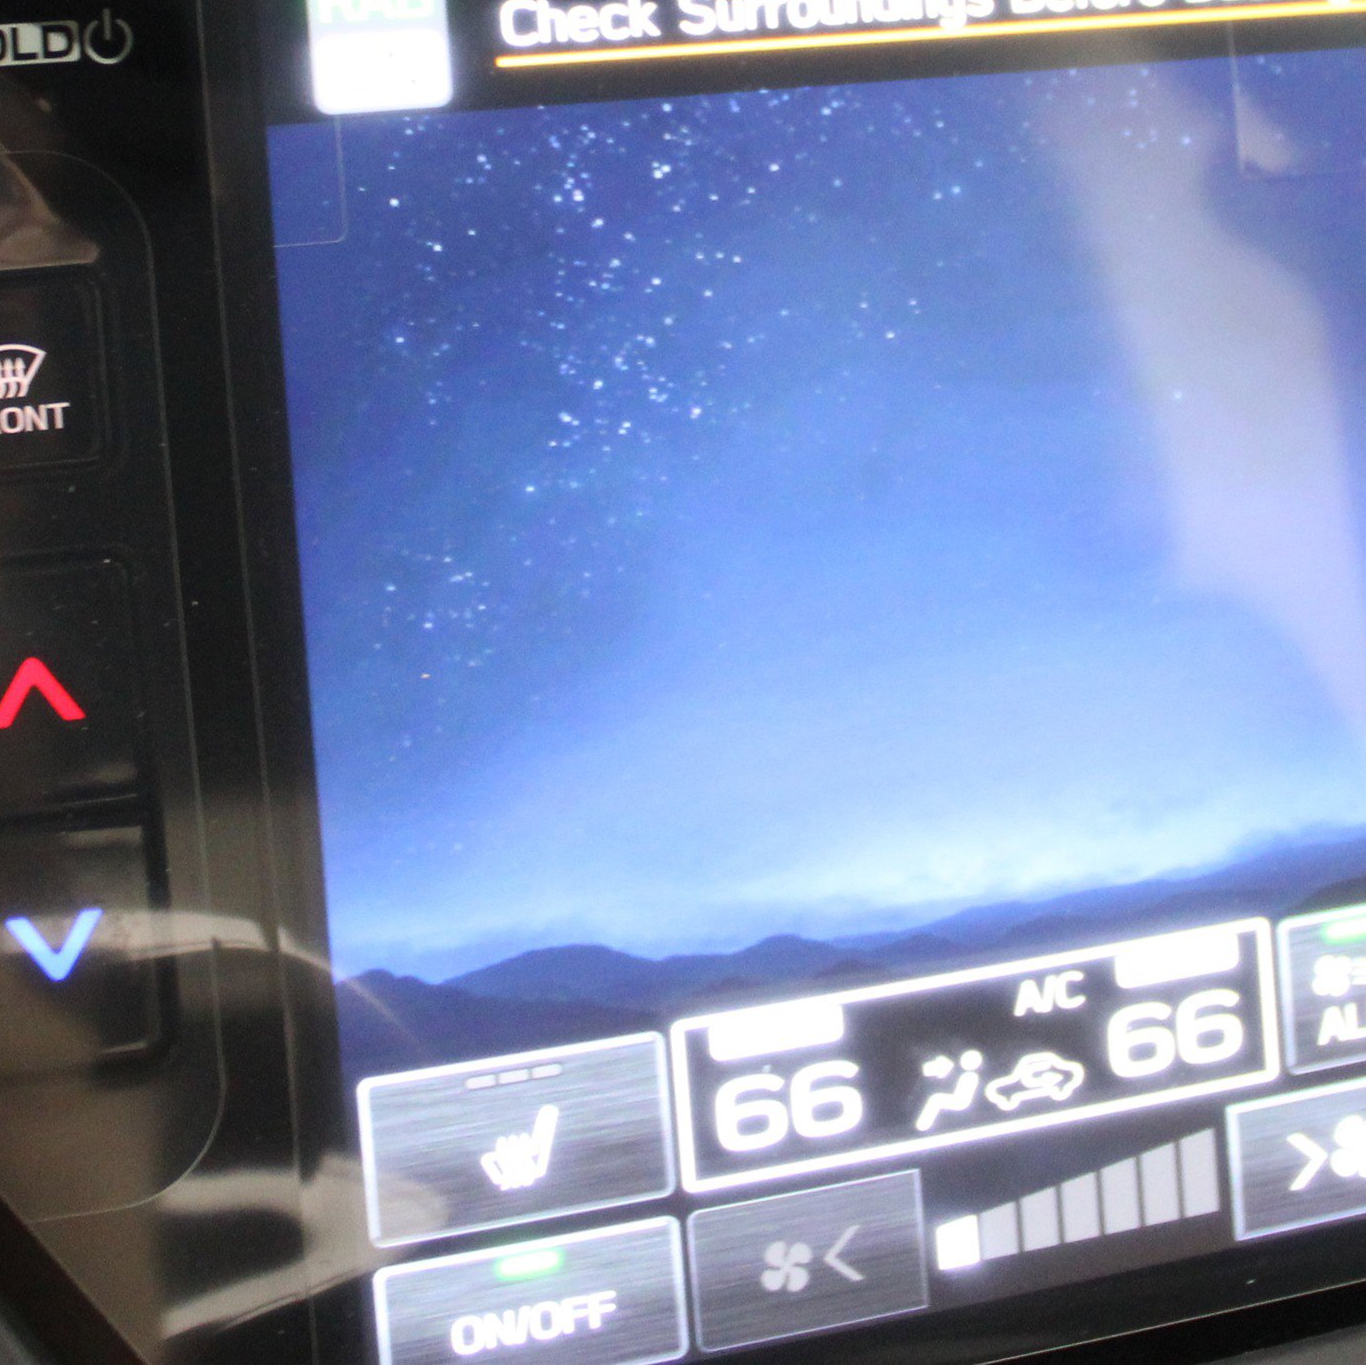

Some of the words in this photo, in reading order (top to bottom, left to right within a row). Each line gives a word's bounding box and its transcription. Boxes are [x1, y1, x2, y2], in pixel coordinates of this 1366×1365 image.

[1013, 970, 1088, 1018] A/C
[1106, 988, 1245, 1079] 66
[714, 1060, 863, 1153] 66
[449, 1290, 619, 1357] ON/OFF
